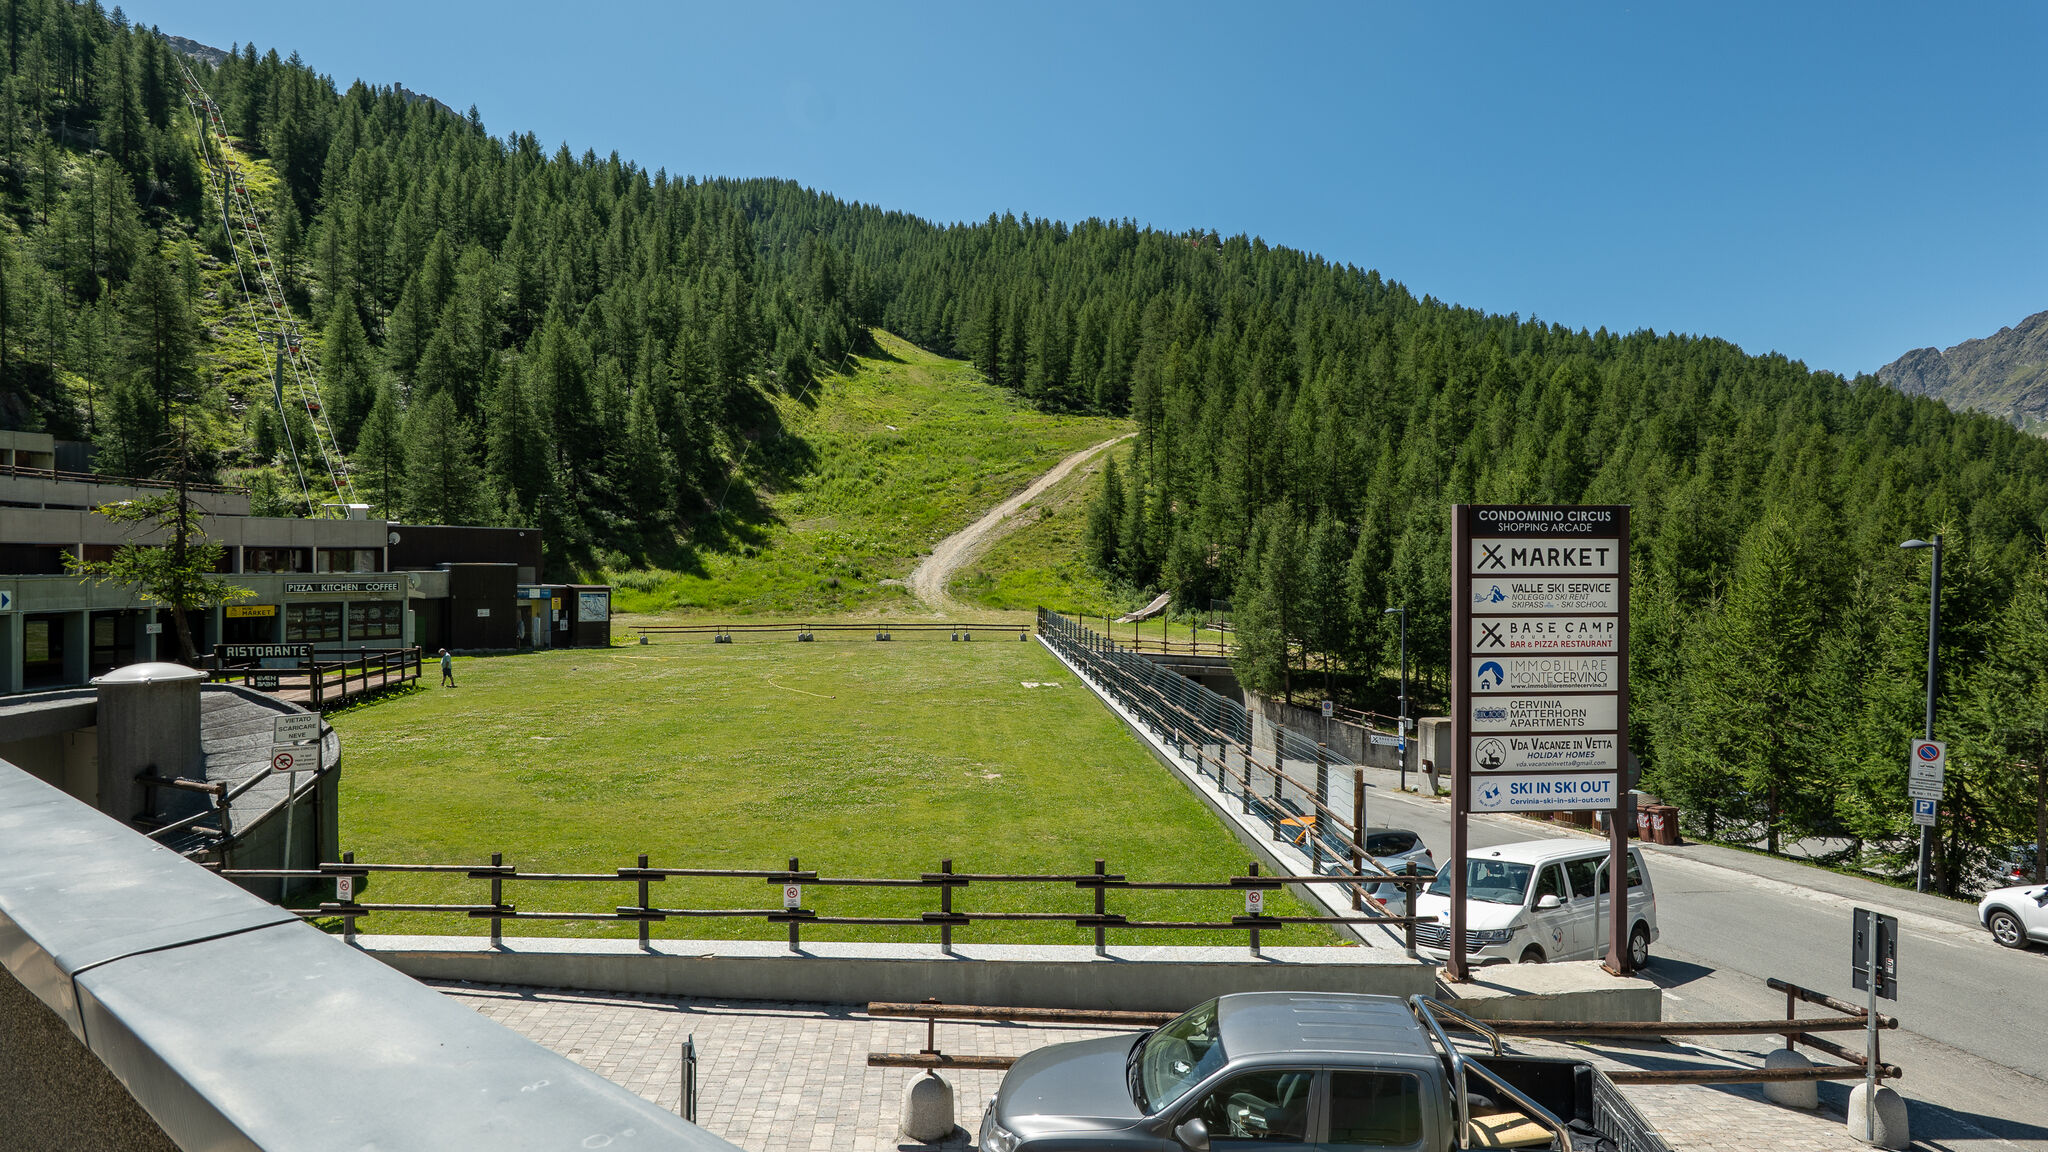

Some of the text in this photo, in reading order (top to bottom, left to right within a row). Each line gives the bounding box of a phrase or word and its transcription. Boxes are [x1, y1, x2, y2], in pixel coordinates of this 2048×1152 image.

[1478, 510, 1611, 521] CONDOMINIO CIRCUS
[1498, 522, 1592, 532] SHOPPING ARCADE
[1511, 547, 1609, 566] MARKET
[321, 583, 358, 591] KITCHEN
[366, 583, 397, 591] COFFEE
[1511, 583, 1611, 593] VALLE SKI SERVICE
[1511, 593, 1553, 601] NOLEGGIO
[1511, 601, 1544, 609] SKIPASS
[1561, 601, 1574, 609] SKI
[1575, 601, 1608, 609] SCHOOL
[1510, 622, 1614, 633] BASE CAMP
[1560, 640, 1612, 648] RESTAURANT
[226, 646, 308, 657] RISTORANTE
[1510, 660, 1607, 672] IMMOBILIARE
[1510, 672, 1608, 683] MONTECERVINO
[1510, 700, 1562, 709] CERVINIA
[1510, 709, 1587, 718] MATTERHORN
[1510, 718, 1585, 727] APARTMENTS
[278, 724, 317, 732] SCARICARE
[1527, 751, 1563, 759] HOLIDAY
[1510, 781, 1610, 794] SKI IN SKI OUT
[1510, 797, 1611, 805] Cervinia-ski-in-ski-out.com
[1919, 802, 1930, 812] P
